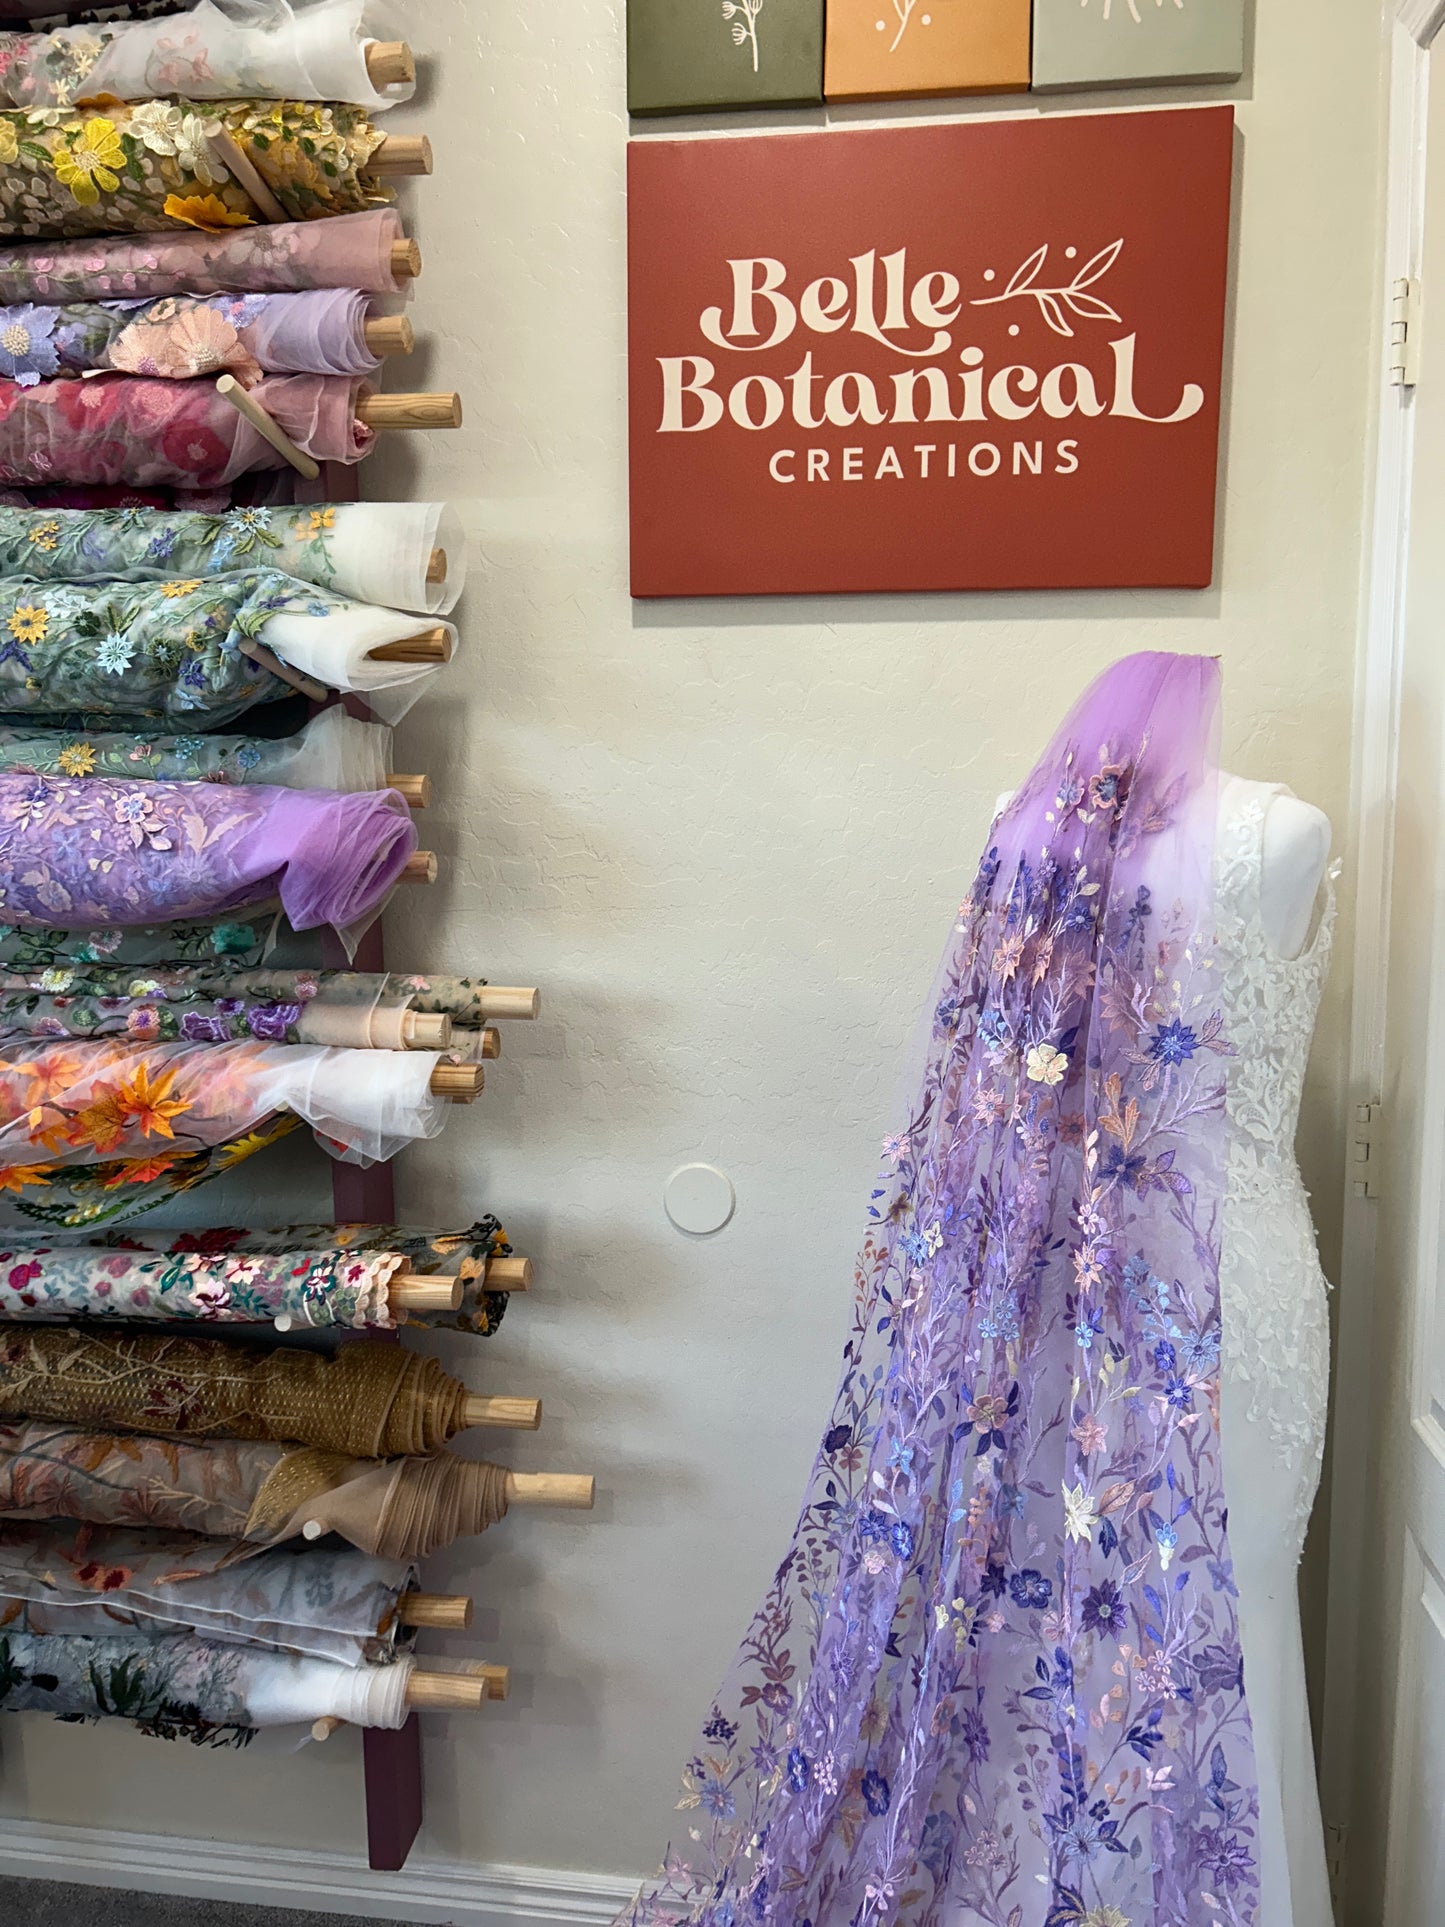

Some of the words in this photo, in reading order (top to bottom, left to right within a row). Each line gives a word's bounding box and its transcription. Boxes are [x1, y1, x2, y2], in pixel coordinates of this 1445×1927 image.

[699, 247, 962, 357] Belle
[655, 332, 1204, 433] Botanical
[769, 439, 1079, 483] CREATIONS
